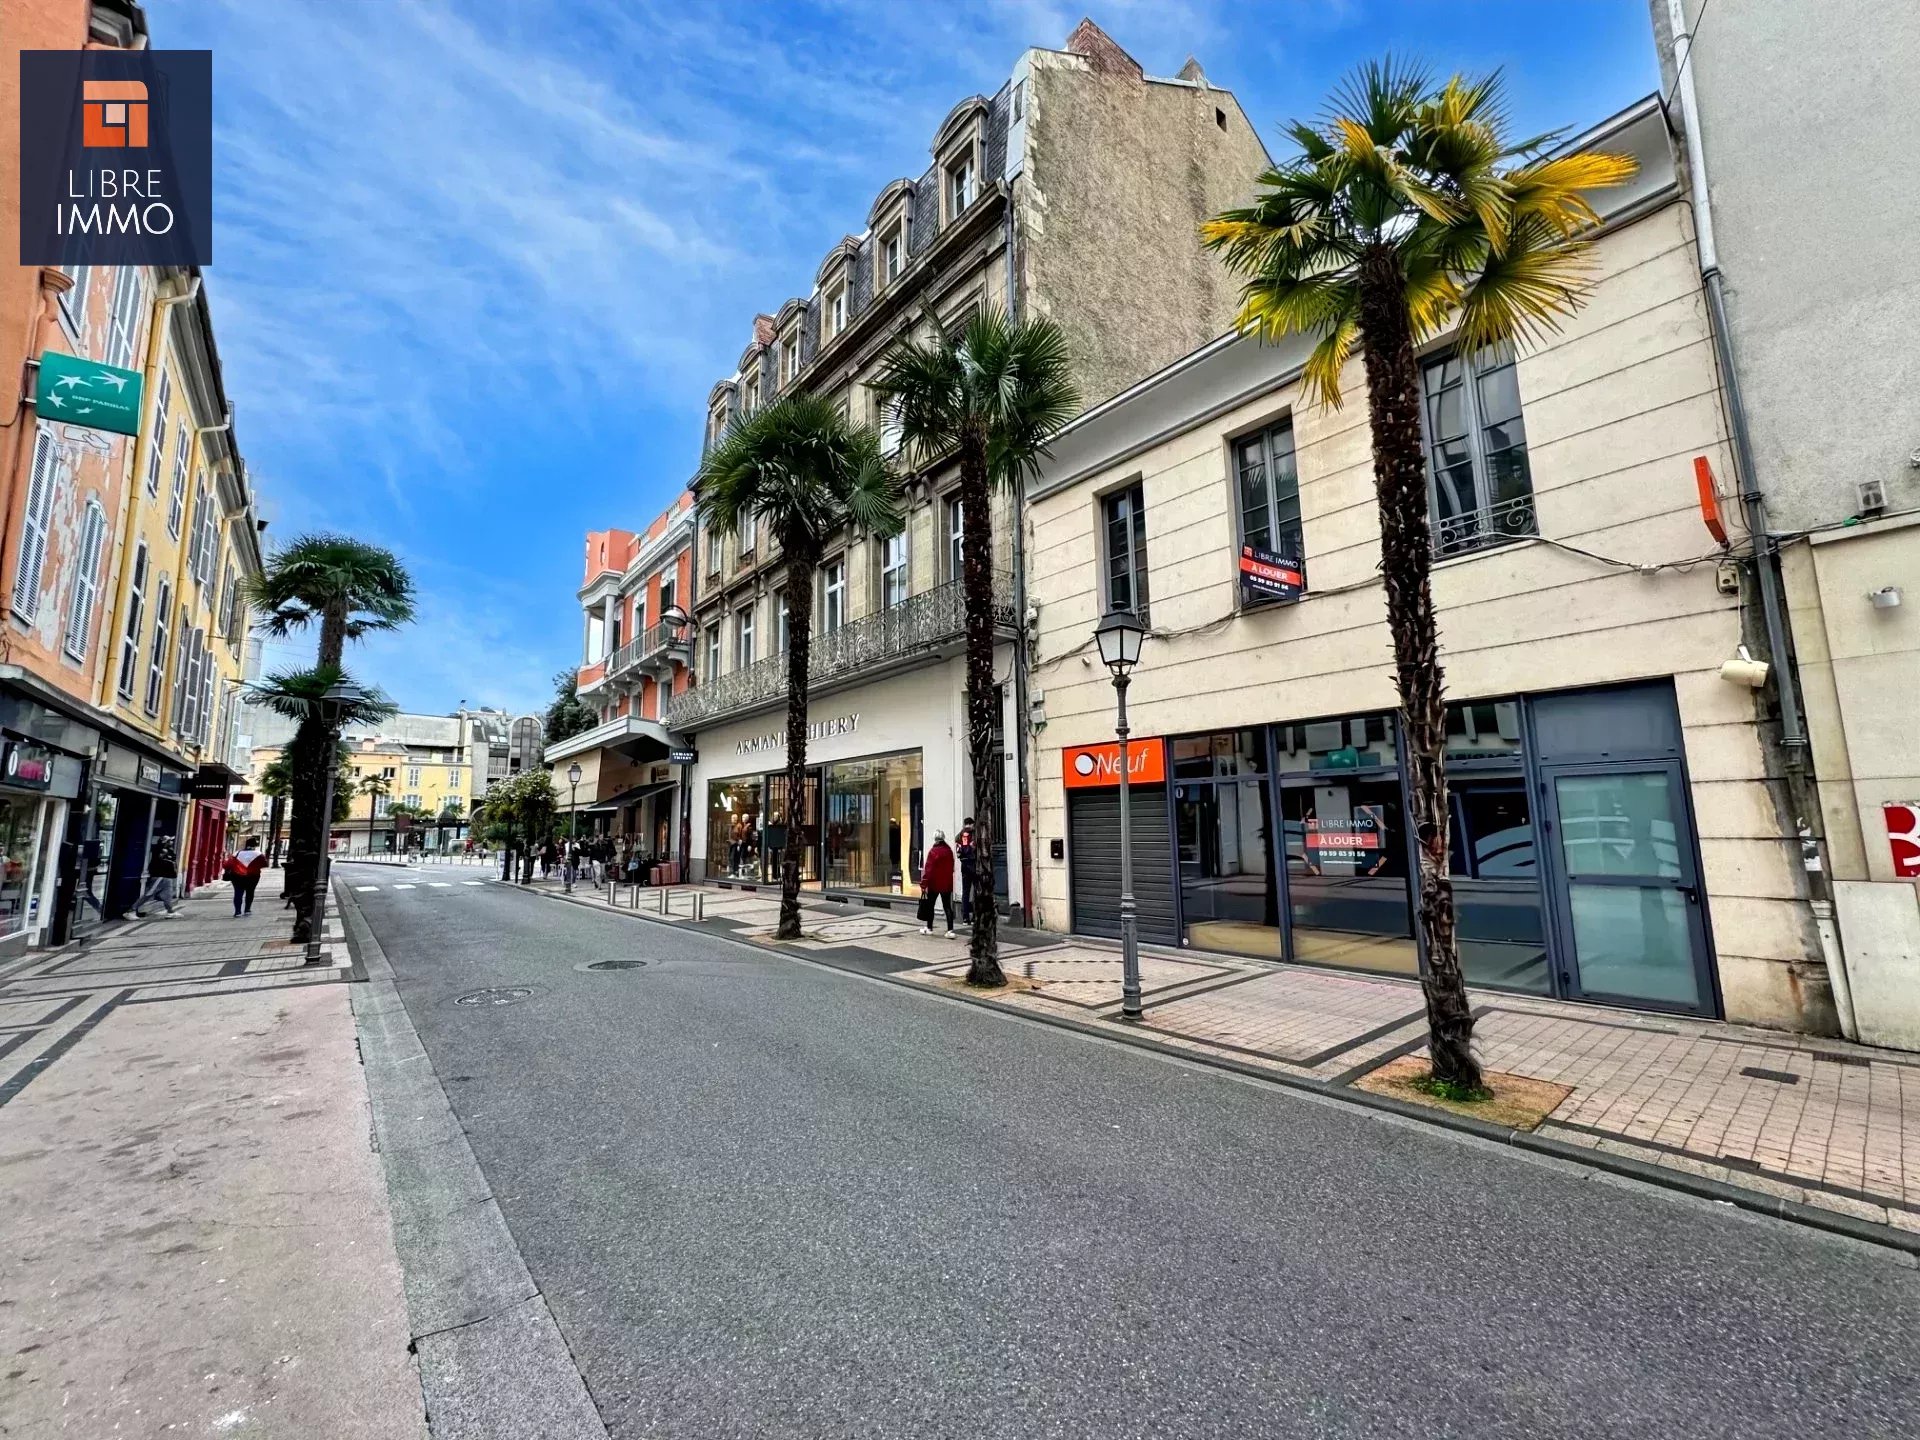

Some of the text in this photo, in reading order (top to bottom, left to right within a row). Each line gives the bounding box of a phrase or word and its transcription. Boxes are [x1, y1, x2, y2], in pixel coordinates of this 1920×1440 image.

[1254, 551, 1298, 568] LIBRE IMMO
[1259, 567, 1288, 580] LOUER
[806, 713, 860, 742] HIERY
[1322, 820, 1374, 828] LIBRE IMMO
[1328, 836, 1363, 845] LOUER
